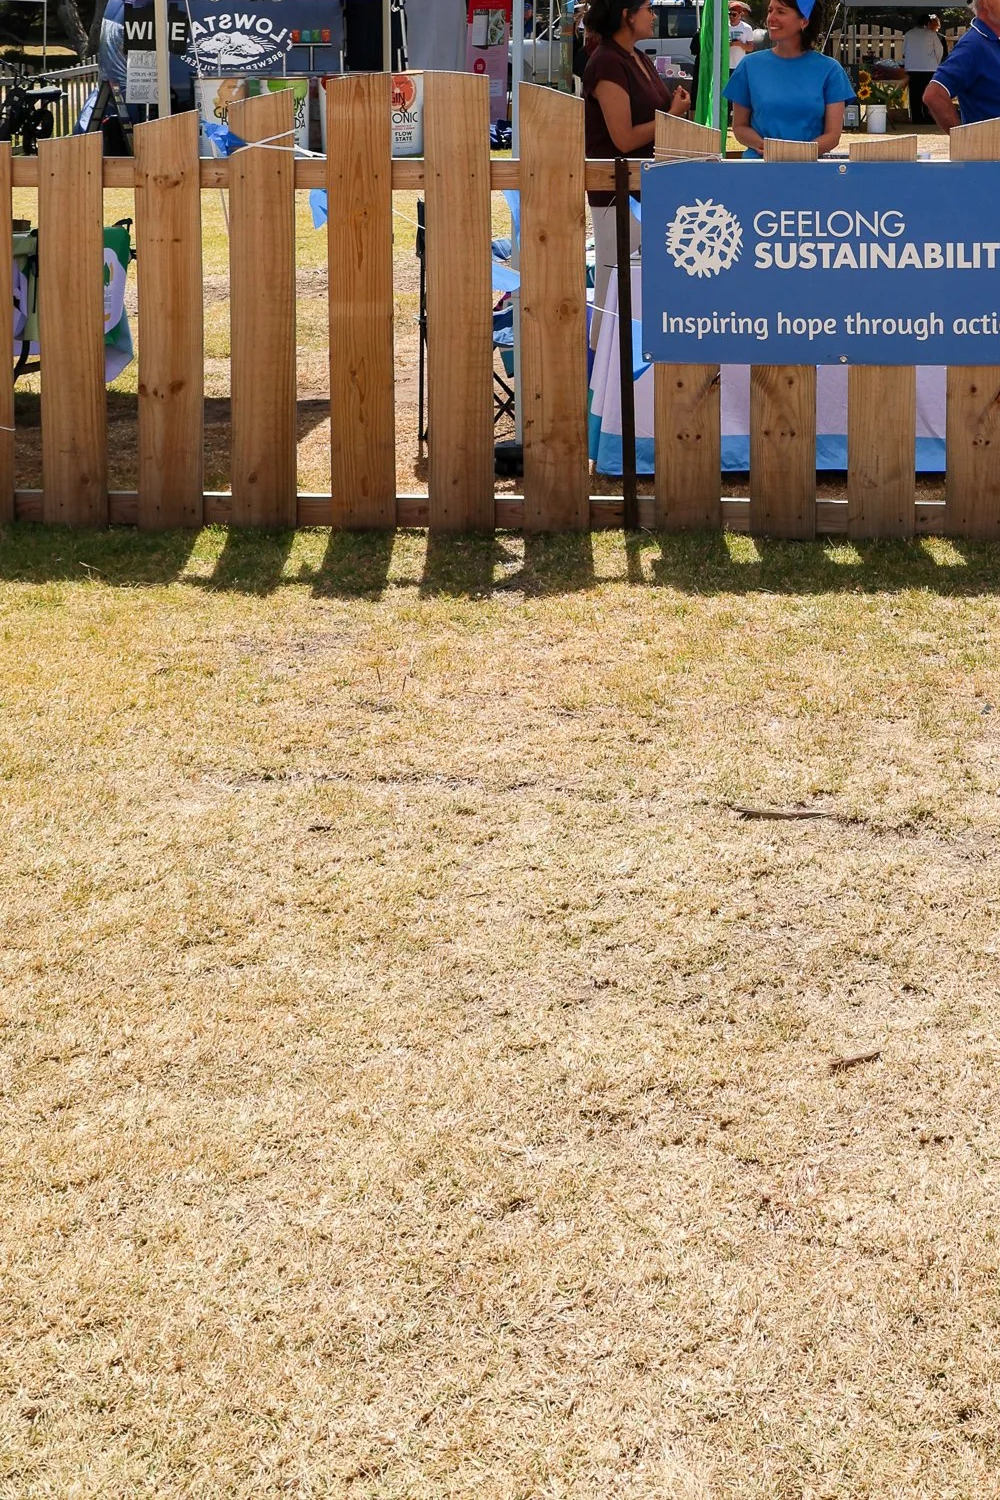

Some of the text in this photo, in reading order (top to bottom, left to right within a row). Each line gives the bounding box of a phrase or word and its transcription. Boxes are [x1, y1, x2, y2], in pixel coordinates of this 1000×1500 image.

[125, 21, 186, 41] WIE
[392, 112, 419, 124] ONIC
[753, 210, 906, 238] GEELONG
[662, 311, 769, 341] Inspiring
[777, 311, 837, 341] hope
[844, 312, 945, 341] through
